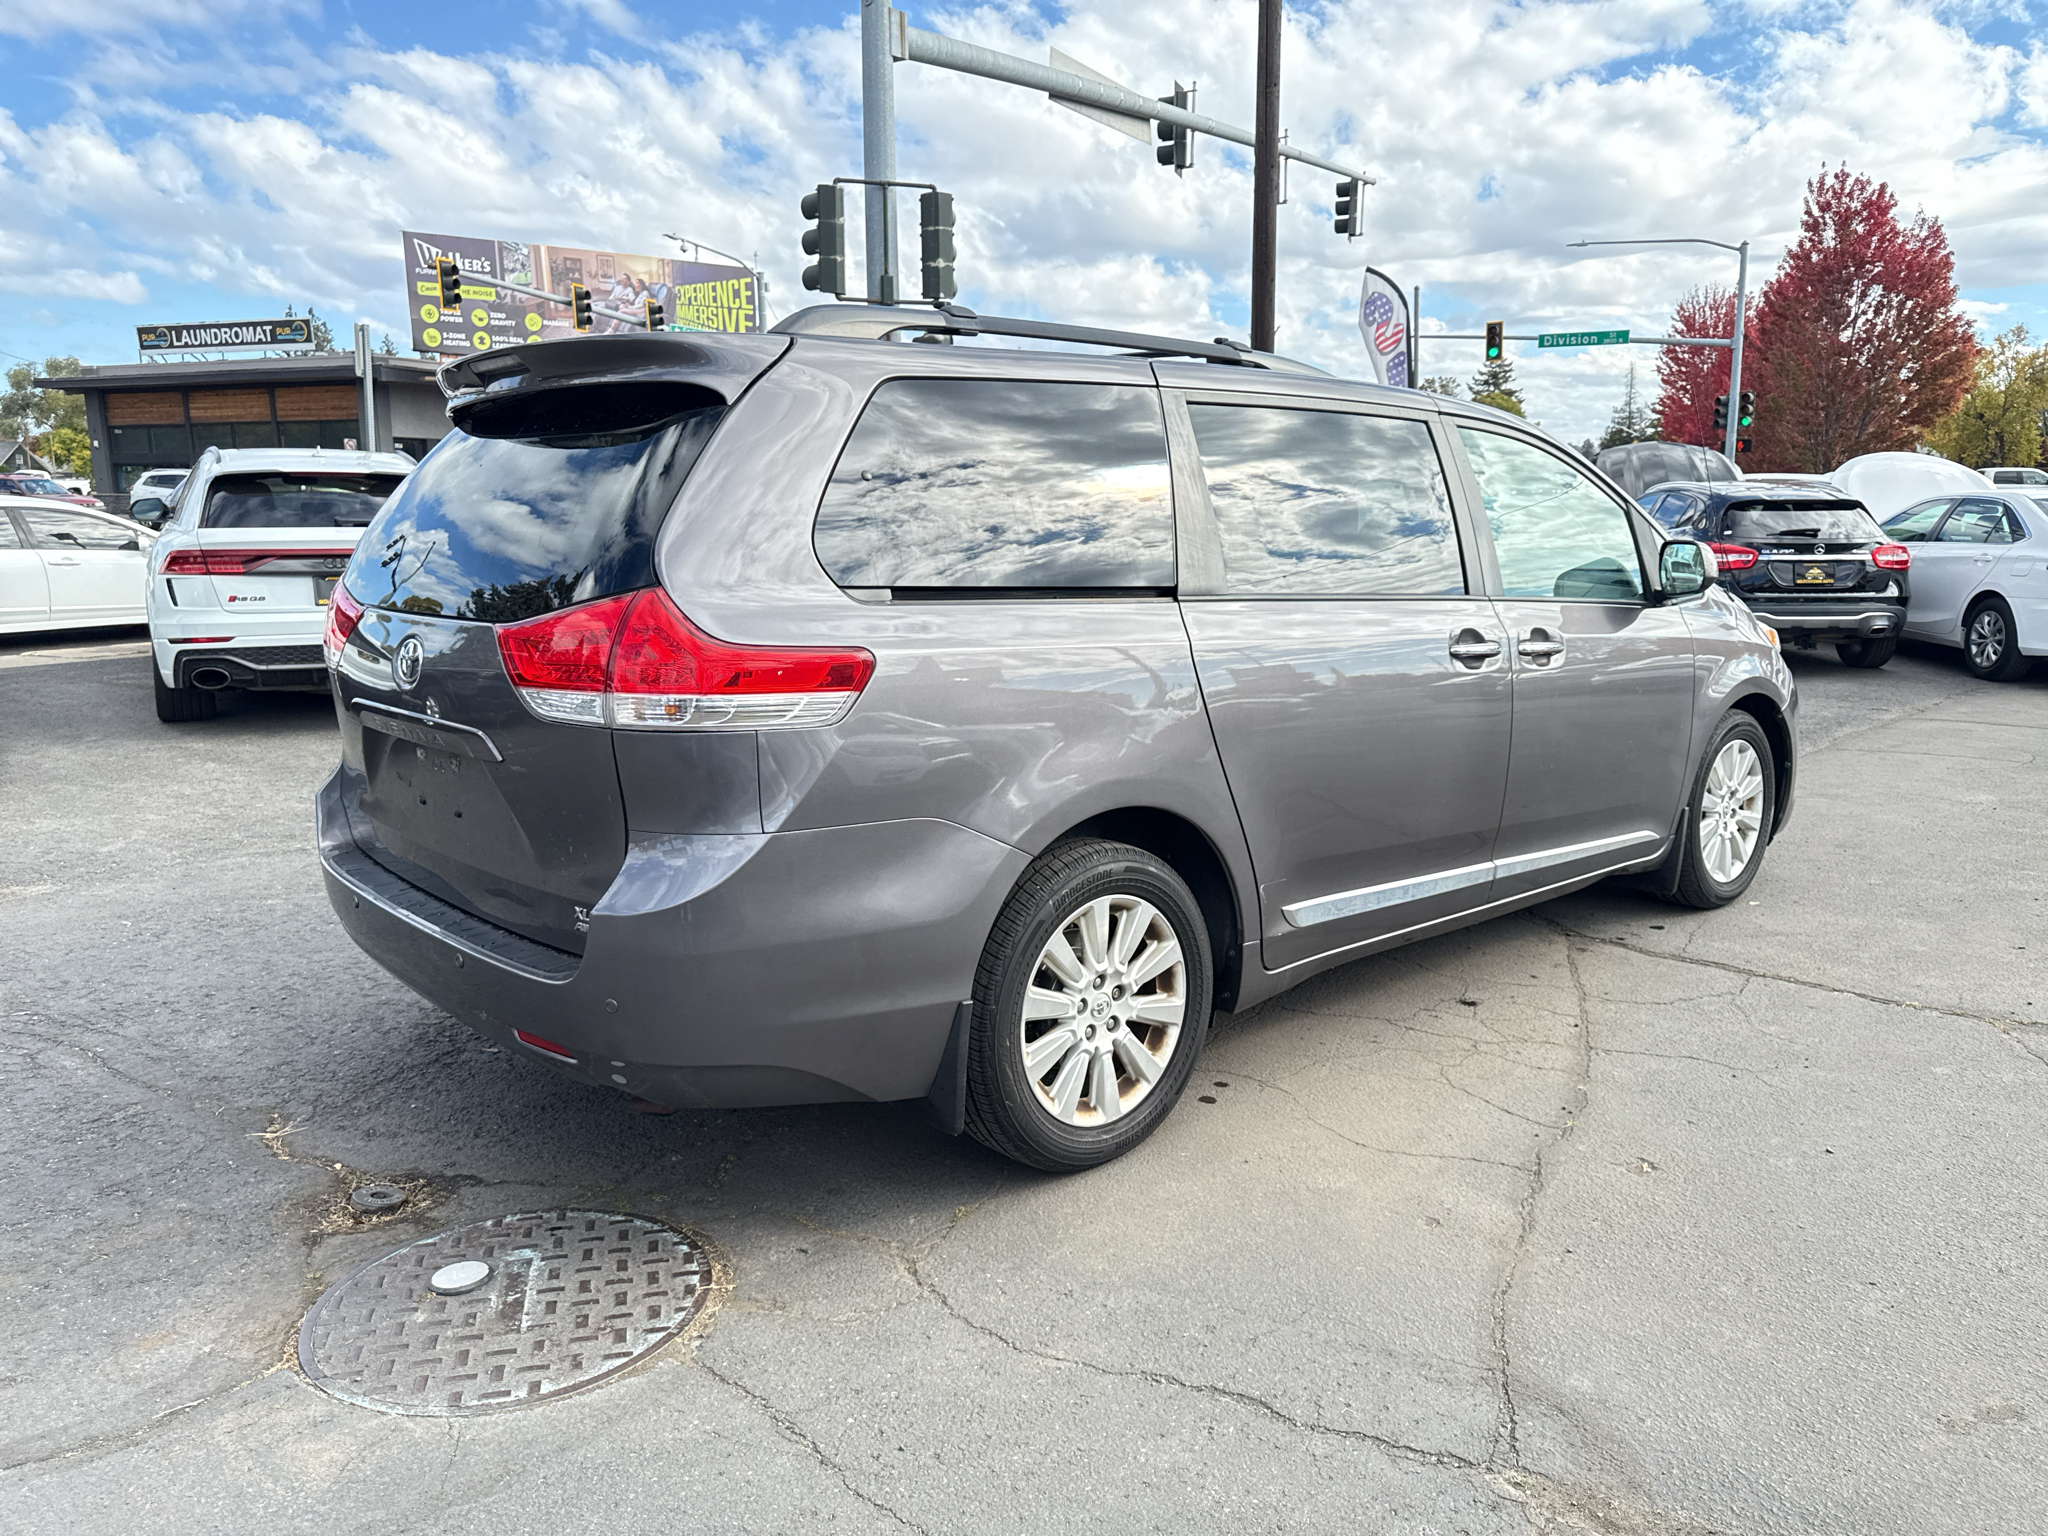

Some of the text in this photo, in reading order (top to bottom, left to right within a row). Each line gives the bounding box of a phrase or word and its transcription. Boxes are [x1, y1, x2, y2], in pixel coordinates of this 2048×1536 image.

[472, 289, 494, 298] NOISE
[675, 277, 754, 310] EXPERIENCE
[440, 315, 464, 323] POWER
[489, 311, 507, 319] ZERO
[676, 303, 754, 333] IMMERSIVE
[542, 319, 570, 327] MASSAGE
[171, 325, 272, 346] LAUNDROMAT
[509, 336, 525, 344] REAL
[1544, 334, 1598, 346] Division
[443, 339, 471, 347] HEATING
[1052, 868, 1115, 913] BRIDGESTONE
